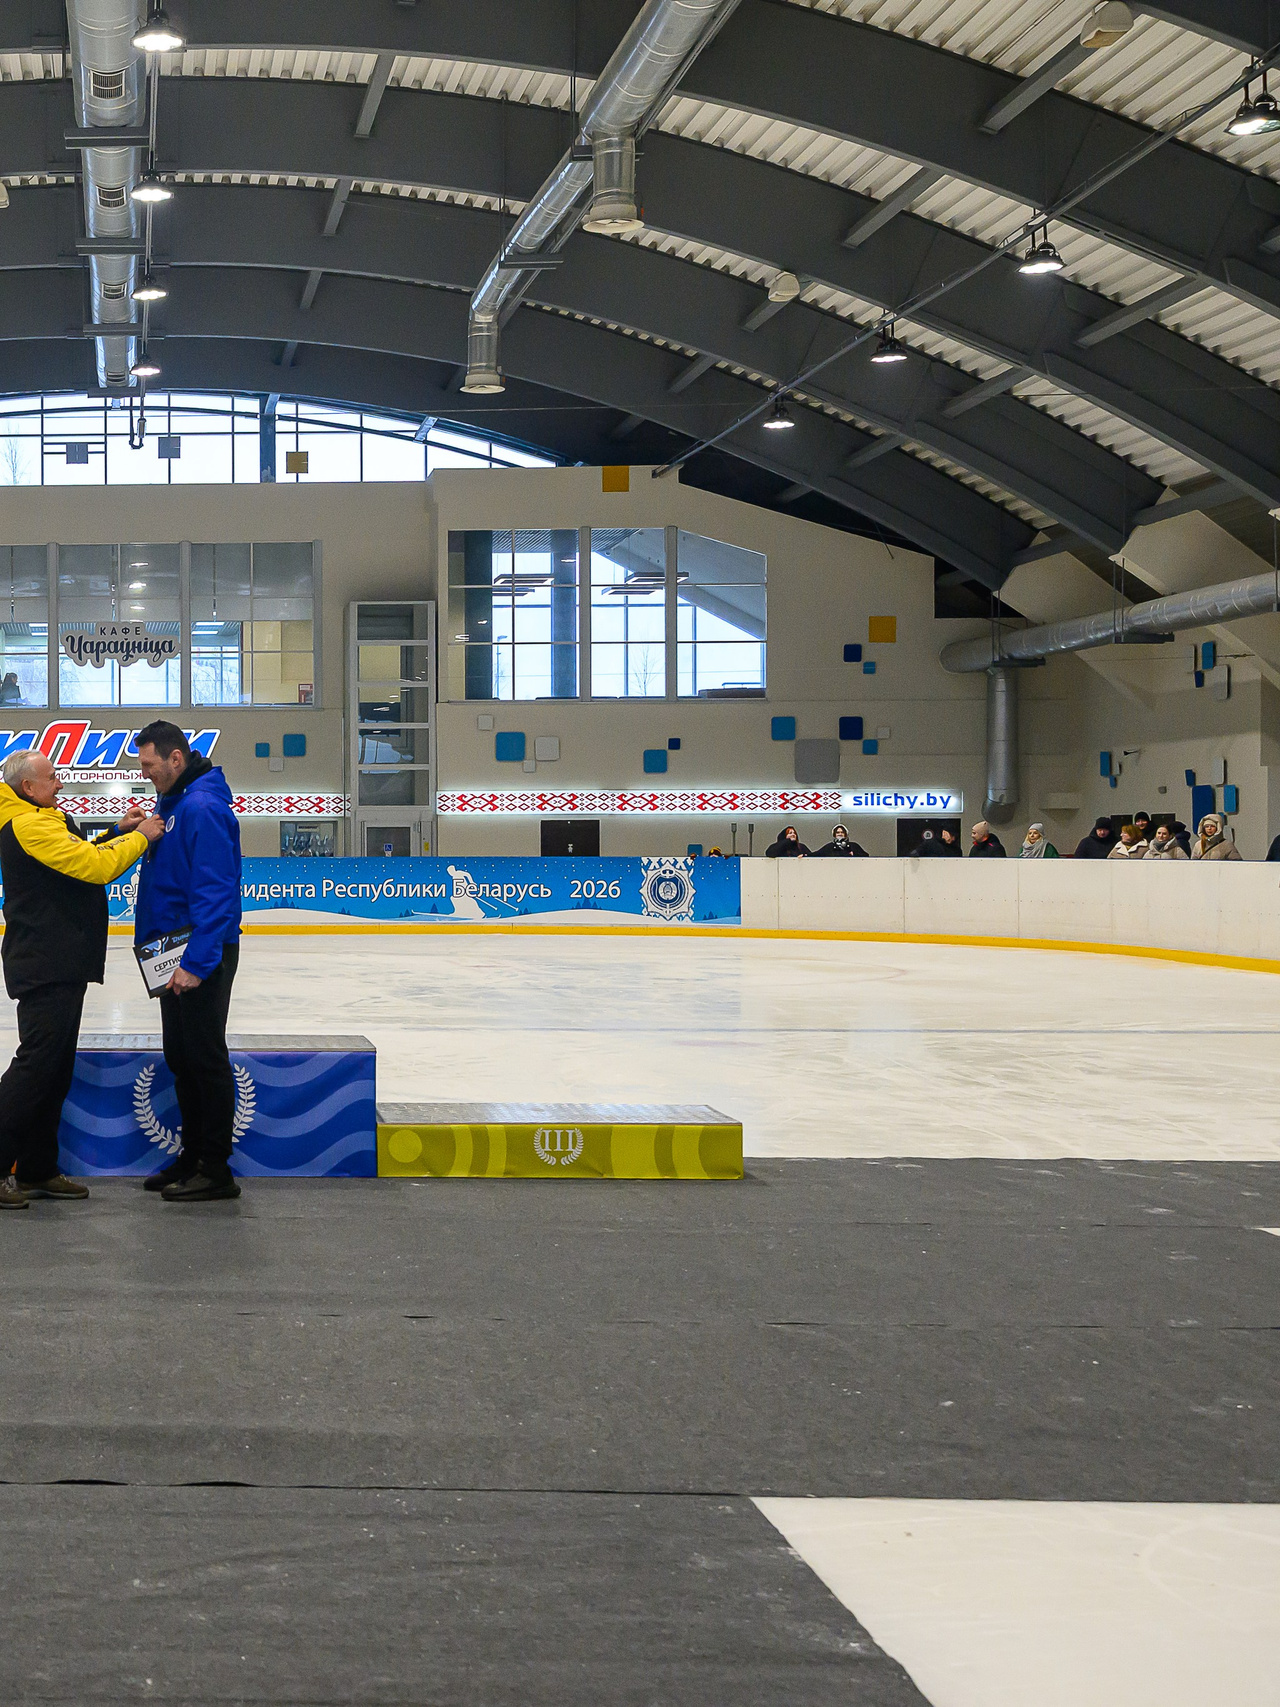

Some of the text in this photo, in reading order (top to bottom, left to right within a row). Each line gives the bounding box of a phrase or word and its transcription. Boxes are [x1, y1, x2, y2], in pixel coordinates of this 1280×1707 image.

[100, 626, 141, 636] КАФЕ
[65, 635, 176, 663] Чараўніца
[853, 792, 952, 809] silichy.by
[322, 877, 447, 904] Республики
[451, 878, 552, 903] Беларусь
[570, 879, 622, 899] 2026
[542, 1129, 575, 1152] III
